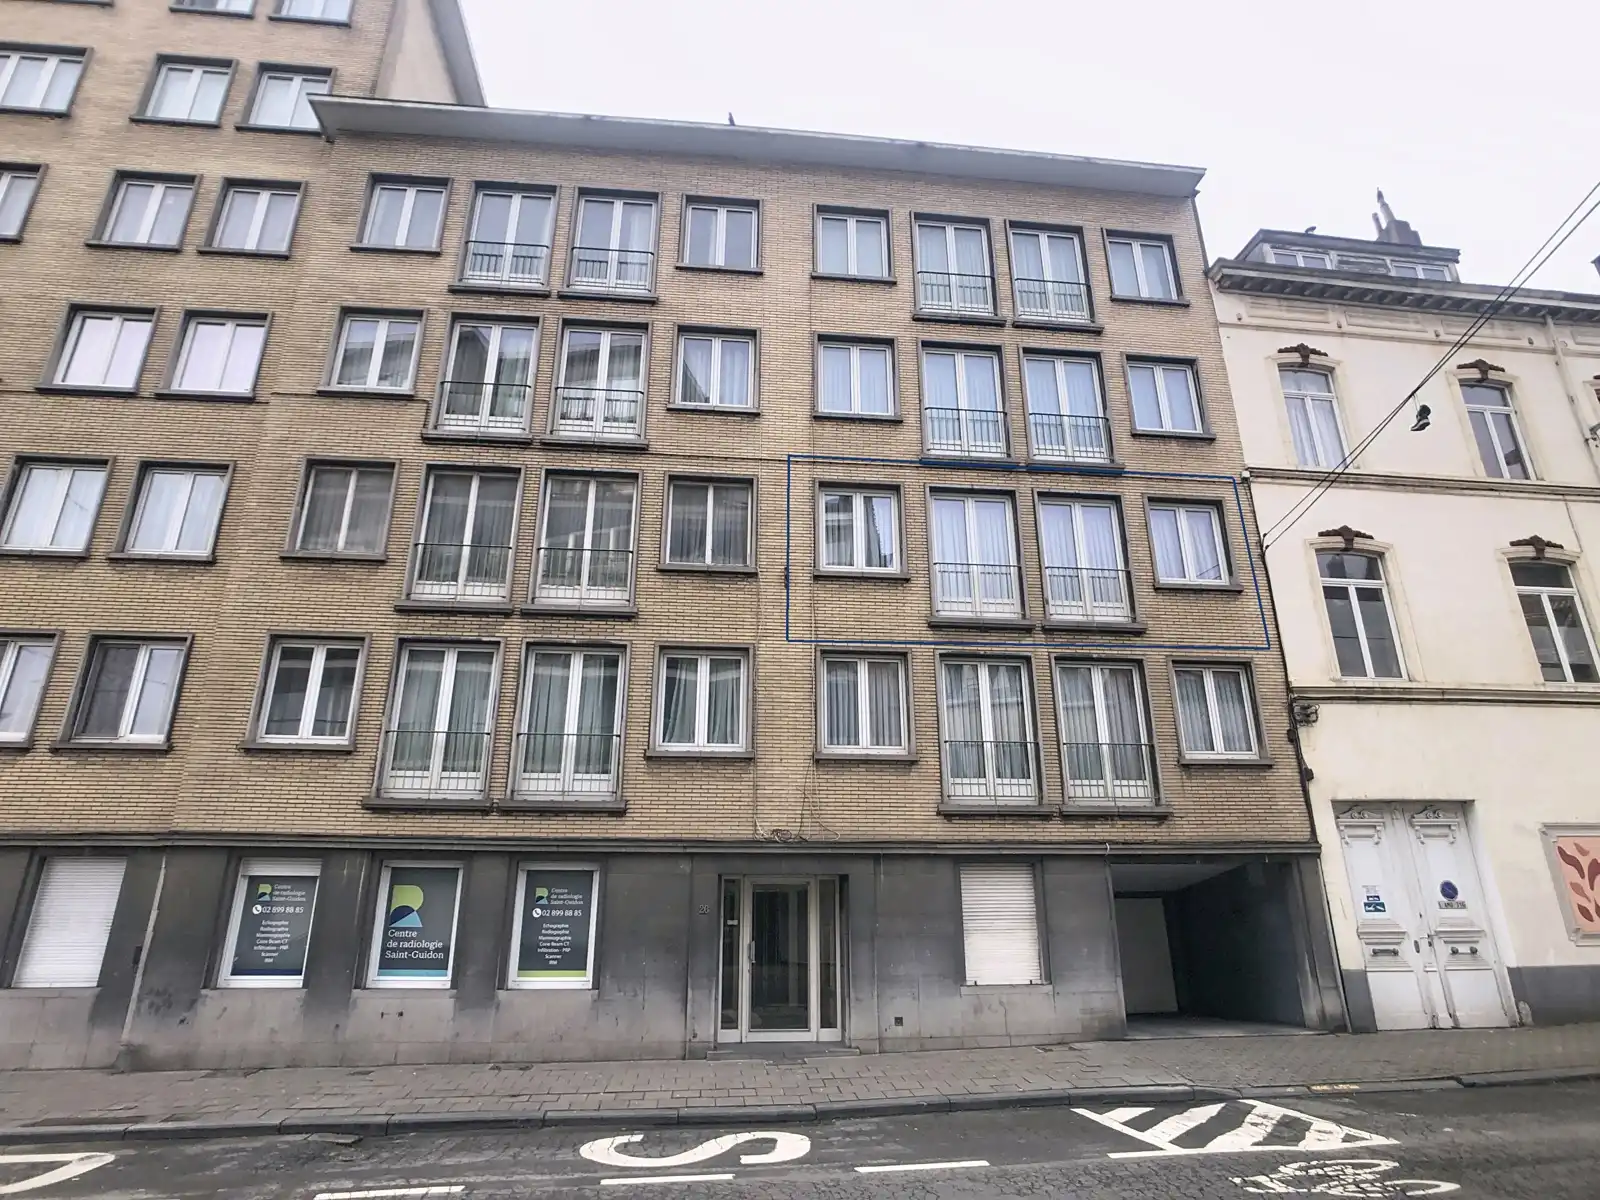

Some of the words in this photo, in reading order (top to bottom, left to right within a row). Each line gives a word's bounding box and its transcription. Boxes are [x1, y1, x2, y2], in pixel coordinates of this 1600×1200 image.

[699, 904, 709, 914] 26
[388, 929, 418, 938] Centre
[386, 939, 398, 948] de
[399, 939, 443, 950] radiologie
[385, 950, 444, 959] Saint-Guidon
